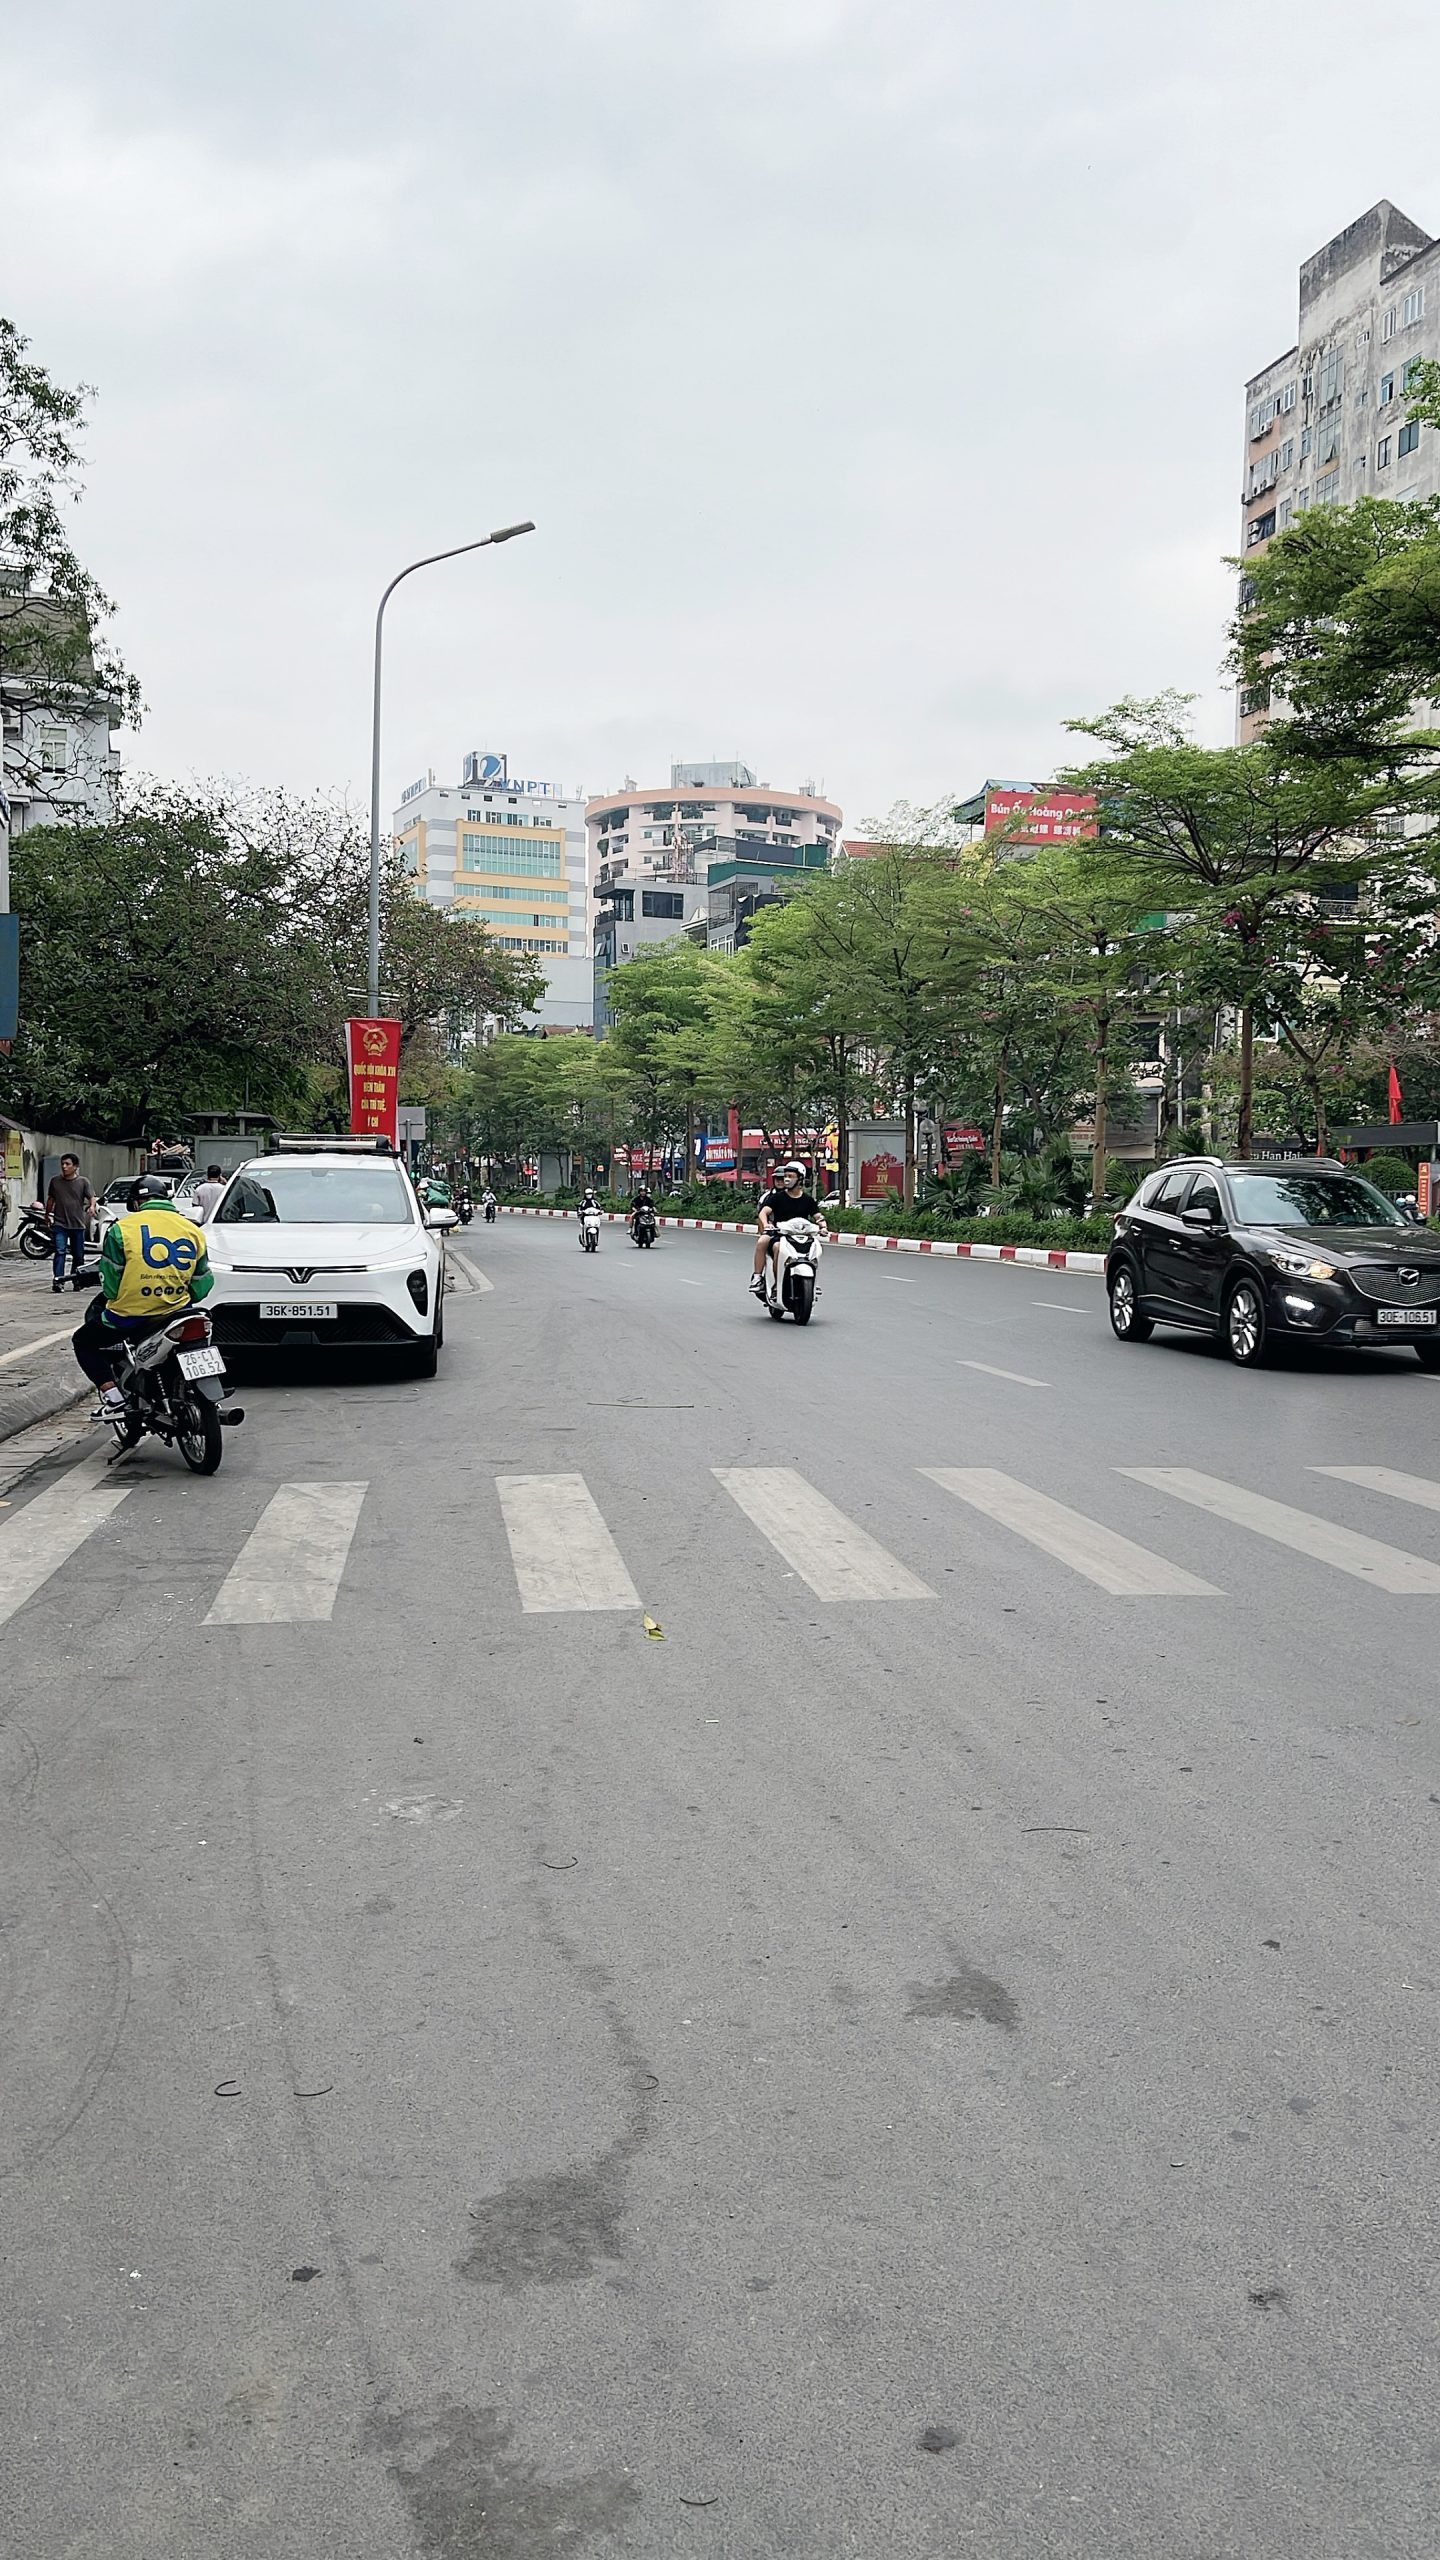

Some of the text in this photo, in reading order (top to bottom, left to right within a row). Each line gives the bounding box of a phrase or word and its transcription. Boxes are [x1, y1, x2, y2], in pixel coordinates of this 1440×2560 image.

[499, 777, 551, 796] VNPT
[991, 803, 1010, 814] Bún
[1029, 806, 1063, 820] Hoàng
[1261, 1150, 1281, 1161] Han
[140, 1225, 196, 1270] be
[266, 1305, 330, 1316] 36K-851.51
[183, 1350, 215, 1366] 26-C1
[185, 1360, 223, 1379] 106.52
